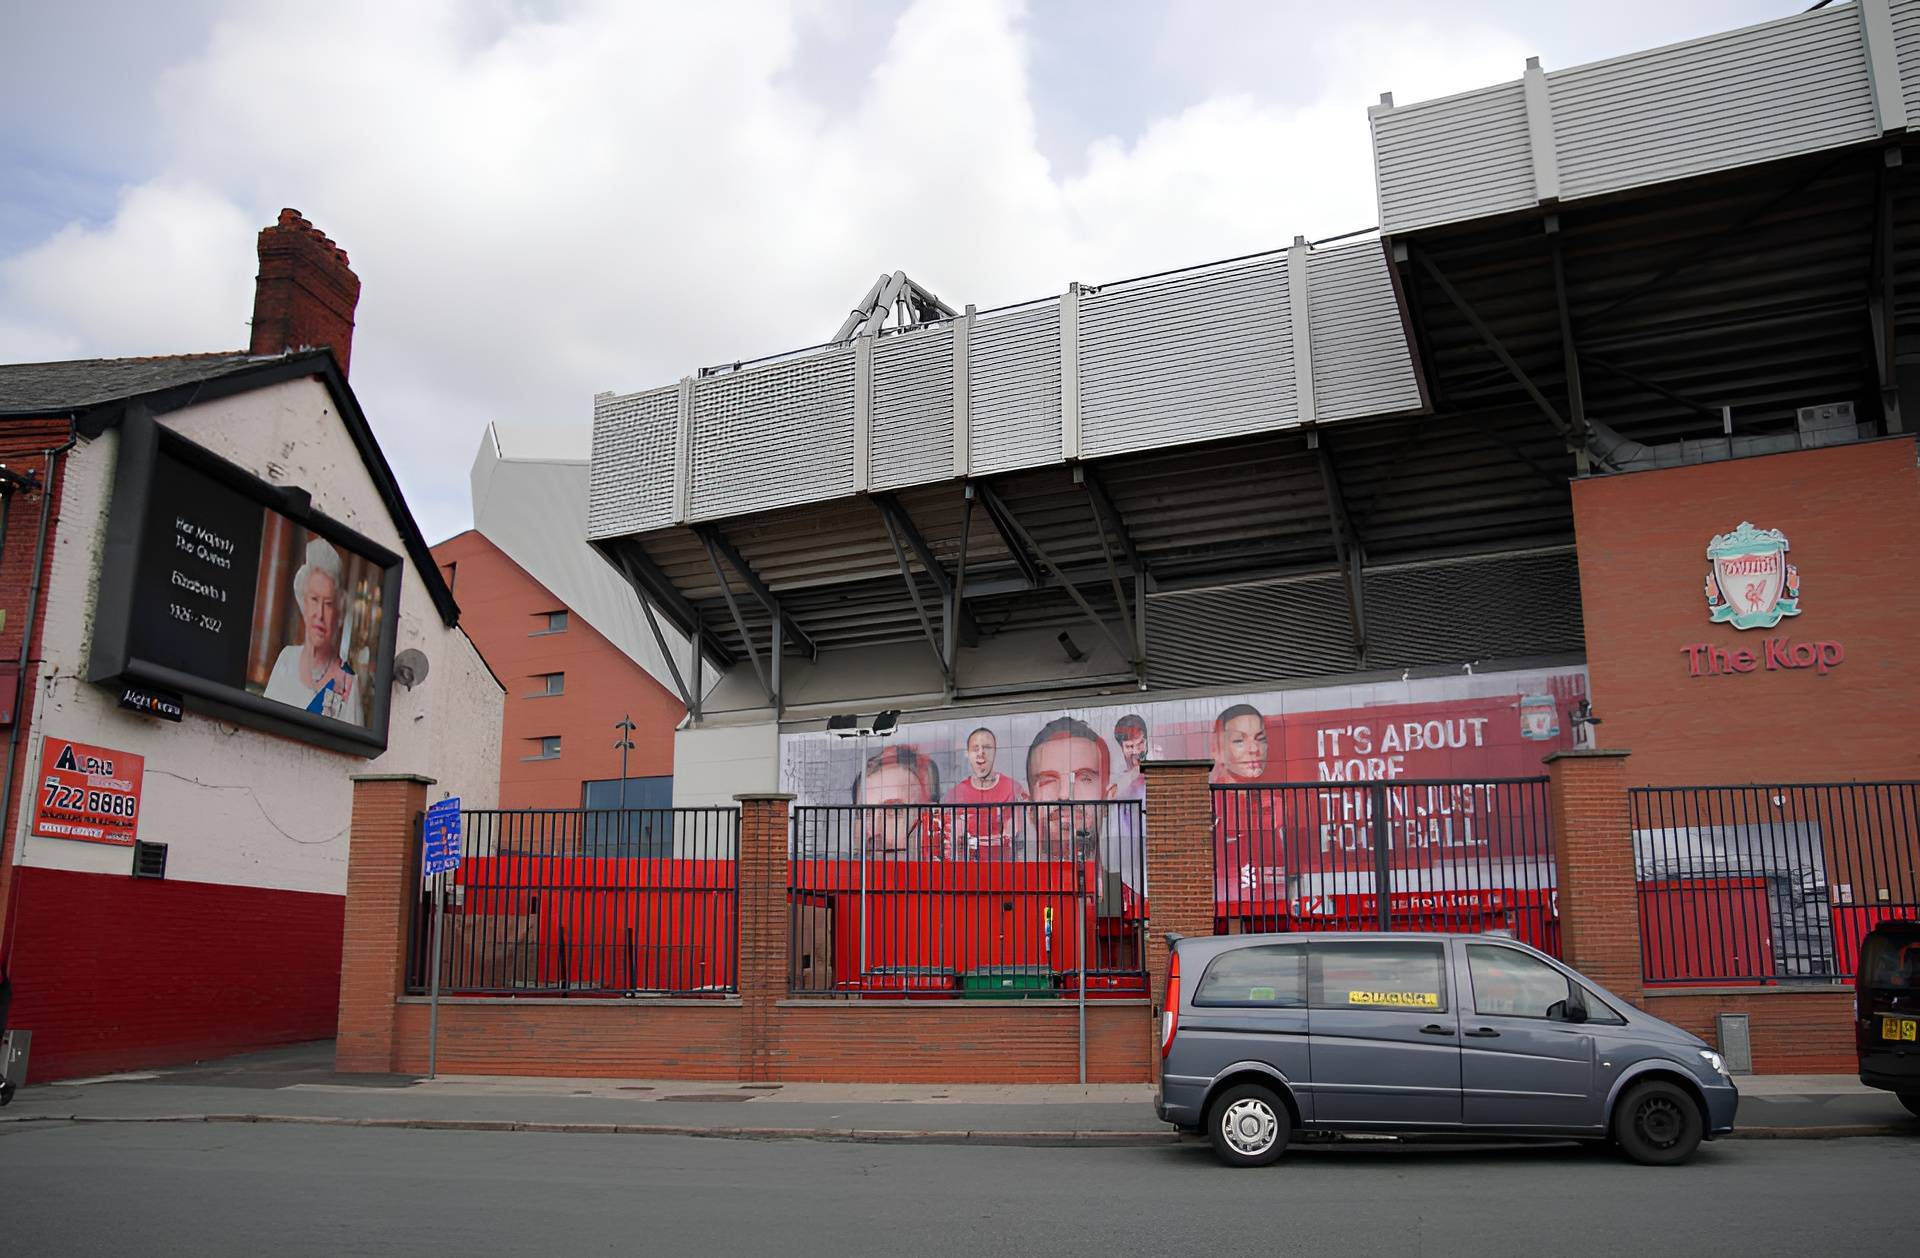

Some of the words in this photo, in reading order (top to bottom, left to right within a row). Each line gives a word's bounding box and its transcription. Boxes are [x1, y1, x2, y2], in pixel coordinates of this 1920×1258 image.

[1679, 642, 1758, 678] The
[1762, 636, 1845, 677] Kop
[1317, 725, 1372, 757] IT'S
[1380, 717, 1489, 753] ABOUT
[1318, 755, 1405, 782] MORE
[44, 783, 84, 812] 722
[87, 791, 137, 819] 8888
